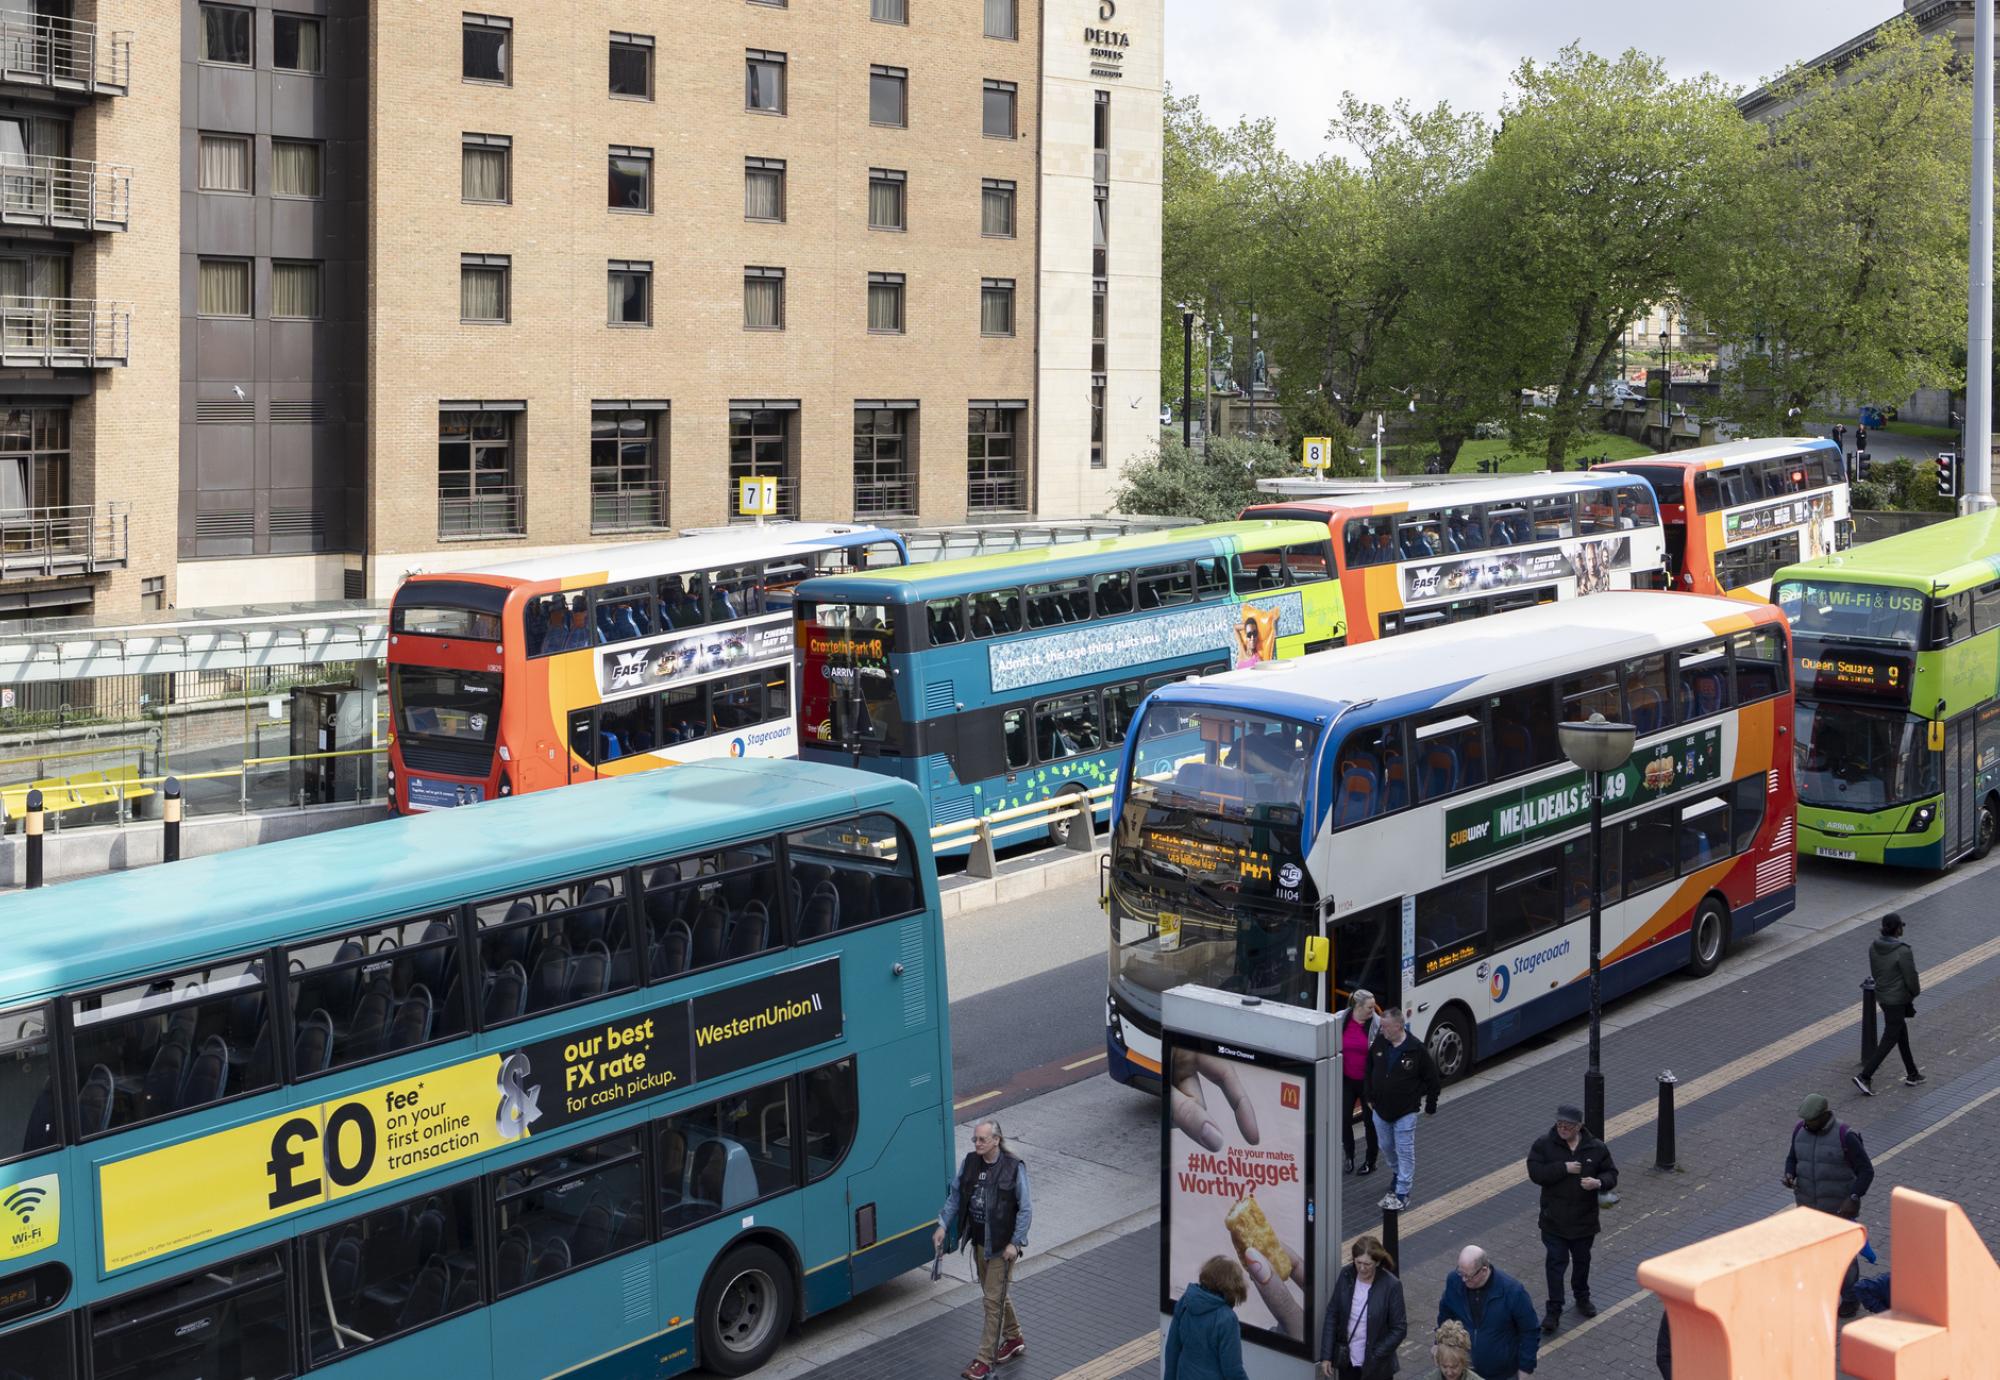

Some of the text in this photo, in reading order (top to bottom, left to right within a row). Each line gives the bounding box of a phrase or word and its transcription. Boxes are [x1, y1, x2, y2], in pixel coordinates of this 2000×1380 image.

[1085, 28, 1130, 47] DELTA
[1311, 446, 1319, 460] 8
[747, 487, 756, 504] 7
[1534, 562, 1548, 571] MAY
[1535, 553, 1562, 563] CINEMAS
[1412, 575, 1440, 590] FAST
[1829, 591, 1871, 607] Wi-Fi
[1874, 593, 1884, 608] &
[1889, 596, 1924, 612] USB
[1180, 620, 1229, 638] WILLIAMS
[762, 635, 788, 648] MAY 19
[810, 638, 883, 658] Croxteth Park 18
[998, 655, 1030, 671] Admit
[1045, 650, 1065, 662] this
[1066, 646, 1086, 660] age
[1087, 641, 1114, 656] thing
[1115, 636, 1140, 650] suits
[612, 660, 648, 680] FAST
[831, 666, 856, 678] ARRIV
[1801, 657, 1899, 686] Queen Square 9
[747, 726, 792, 747] Stagecoach
[1500, 801, 1537, 837] MEAL
[1538, 787, 1579, 824] DEALS
[1449, 821, 1490, 848] SUBWAY
[1827, 821, 1856, 832] ARRIVA
[1276, 888, 1299, 901] 11104
[1513, 939, 1570, 975] Stagecoach
[563, 1018, 654, 1063] our best
[1236, 1050, 1255, 1060] Channel
[565, 1059, 595, 1092] FX
[566, 1070, 677, 1113] for cash pickup.
[386, 1102, 446, 1130] on your
[387, 1114, 470, 1150] first online
[266, 1102, 377, 1210] £0
[388, 1131, 480, 1170] transaction
[1227, 1146, 1295, 1162] Are your mates
[1188, 1153, 1299, 1187] #McNugget
[1178, 1172, 1257, 1202] Worthy?
[12, 1228, 42, 1245] Wi-Fi
